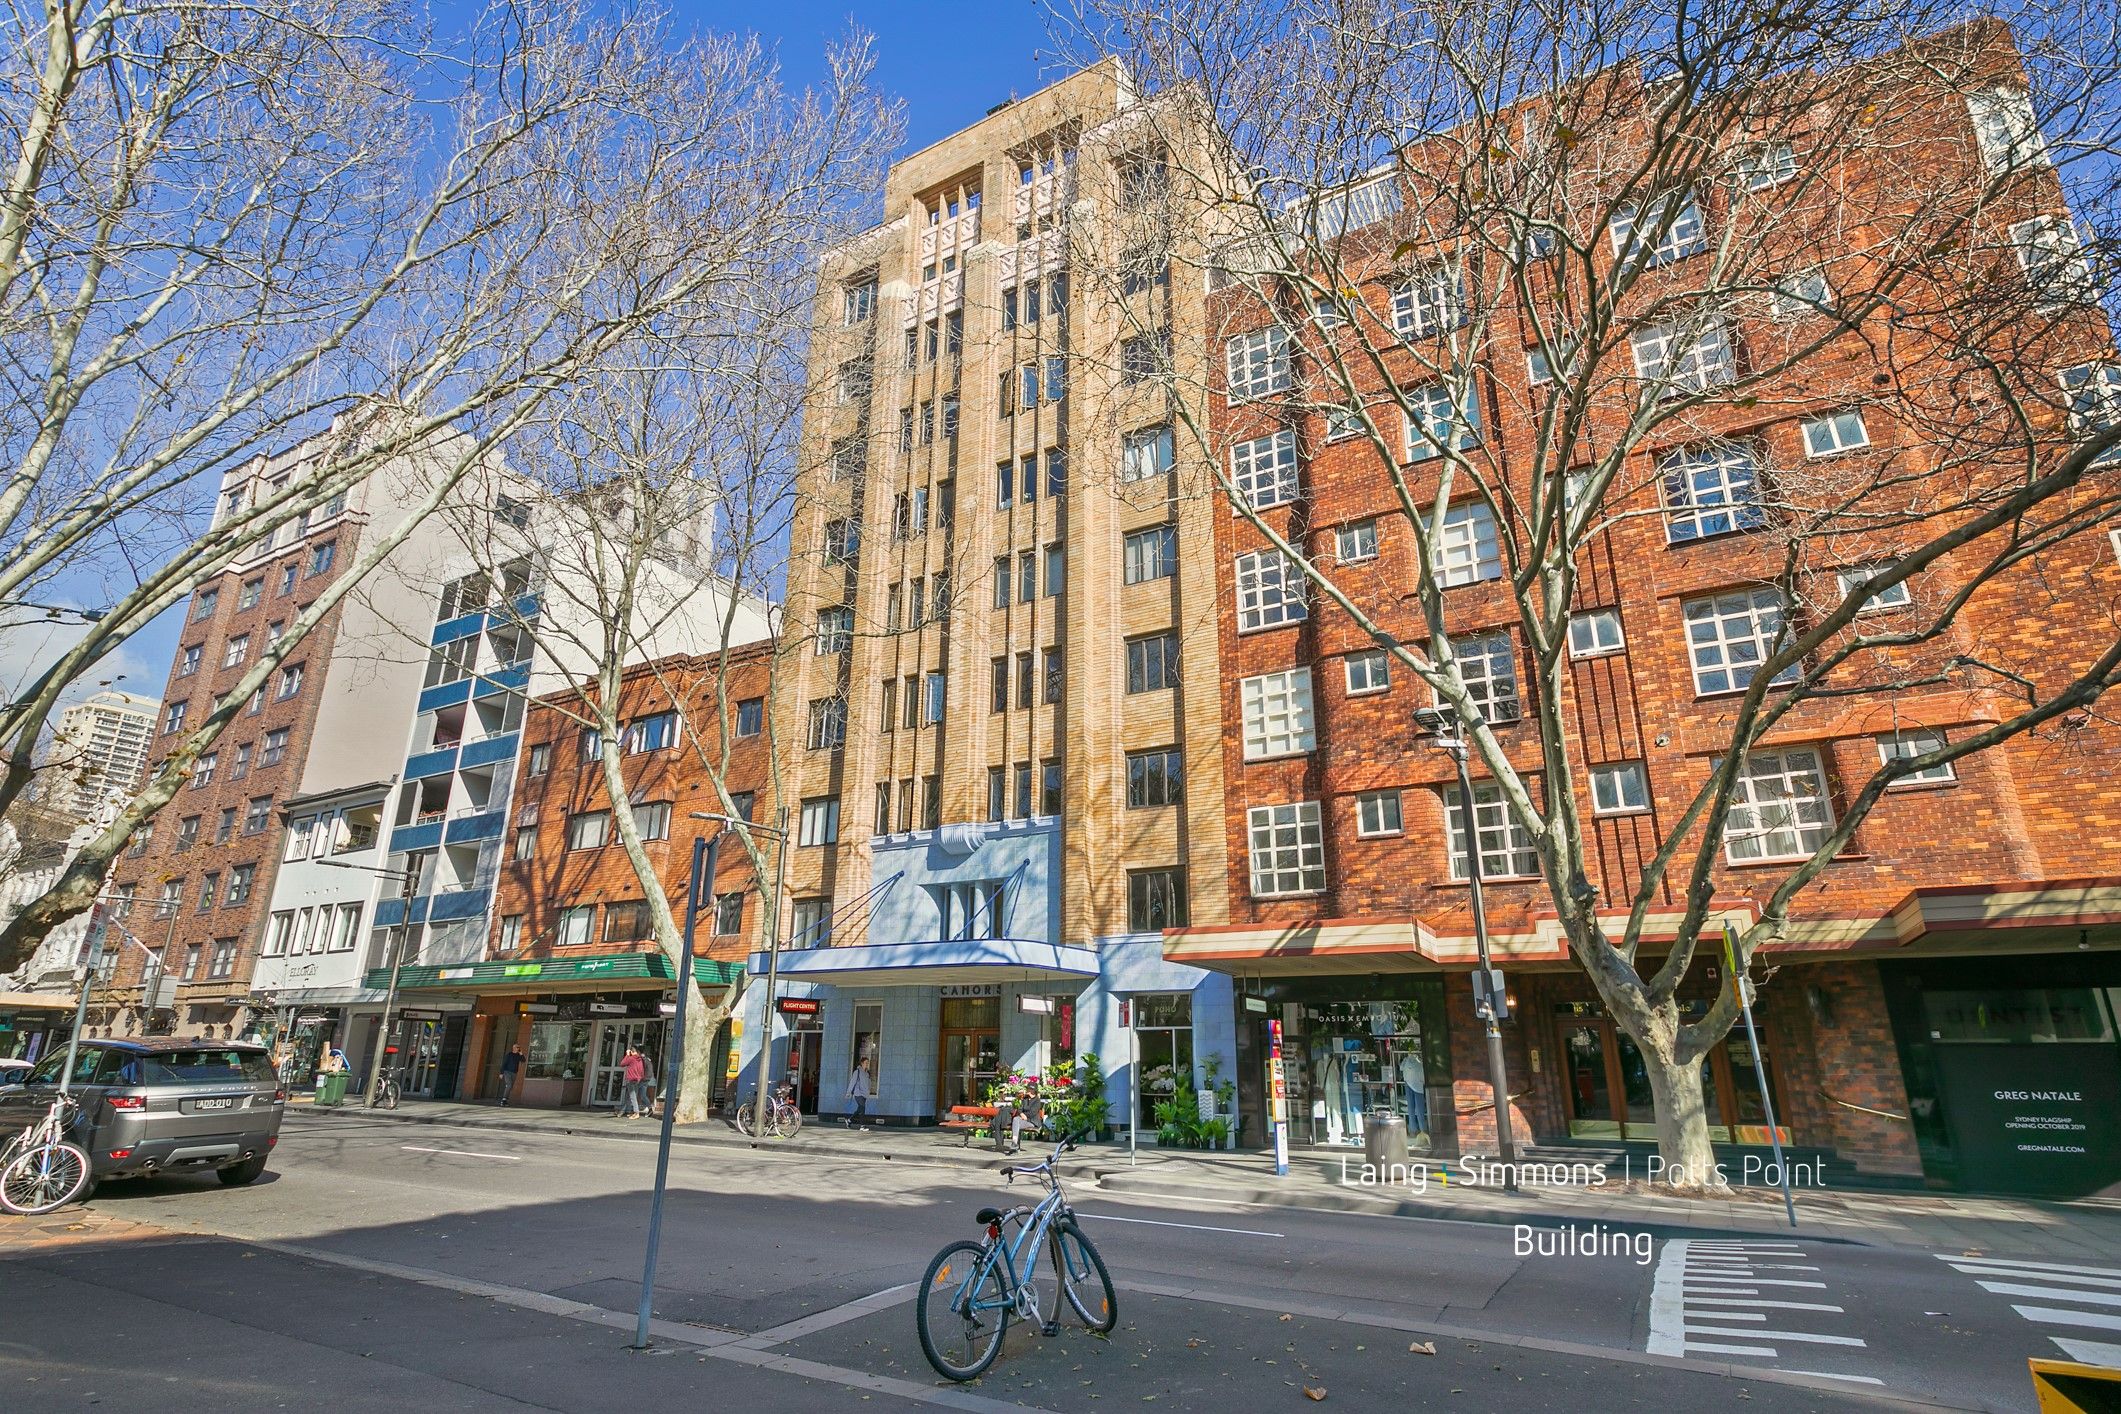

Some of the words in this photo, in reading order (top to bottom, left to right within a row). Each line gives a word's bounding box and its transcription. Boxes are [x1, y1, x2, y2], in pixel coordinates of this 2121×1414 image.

[940, 984, 1001, 999] CAHORS
[1994, 1091, 2028, 1100] GREG
[2031, 1091, 2082, 1101] NATALE
[2017, 1144, 2085, 1153] GREGNATALE.COM
